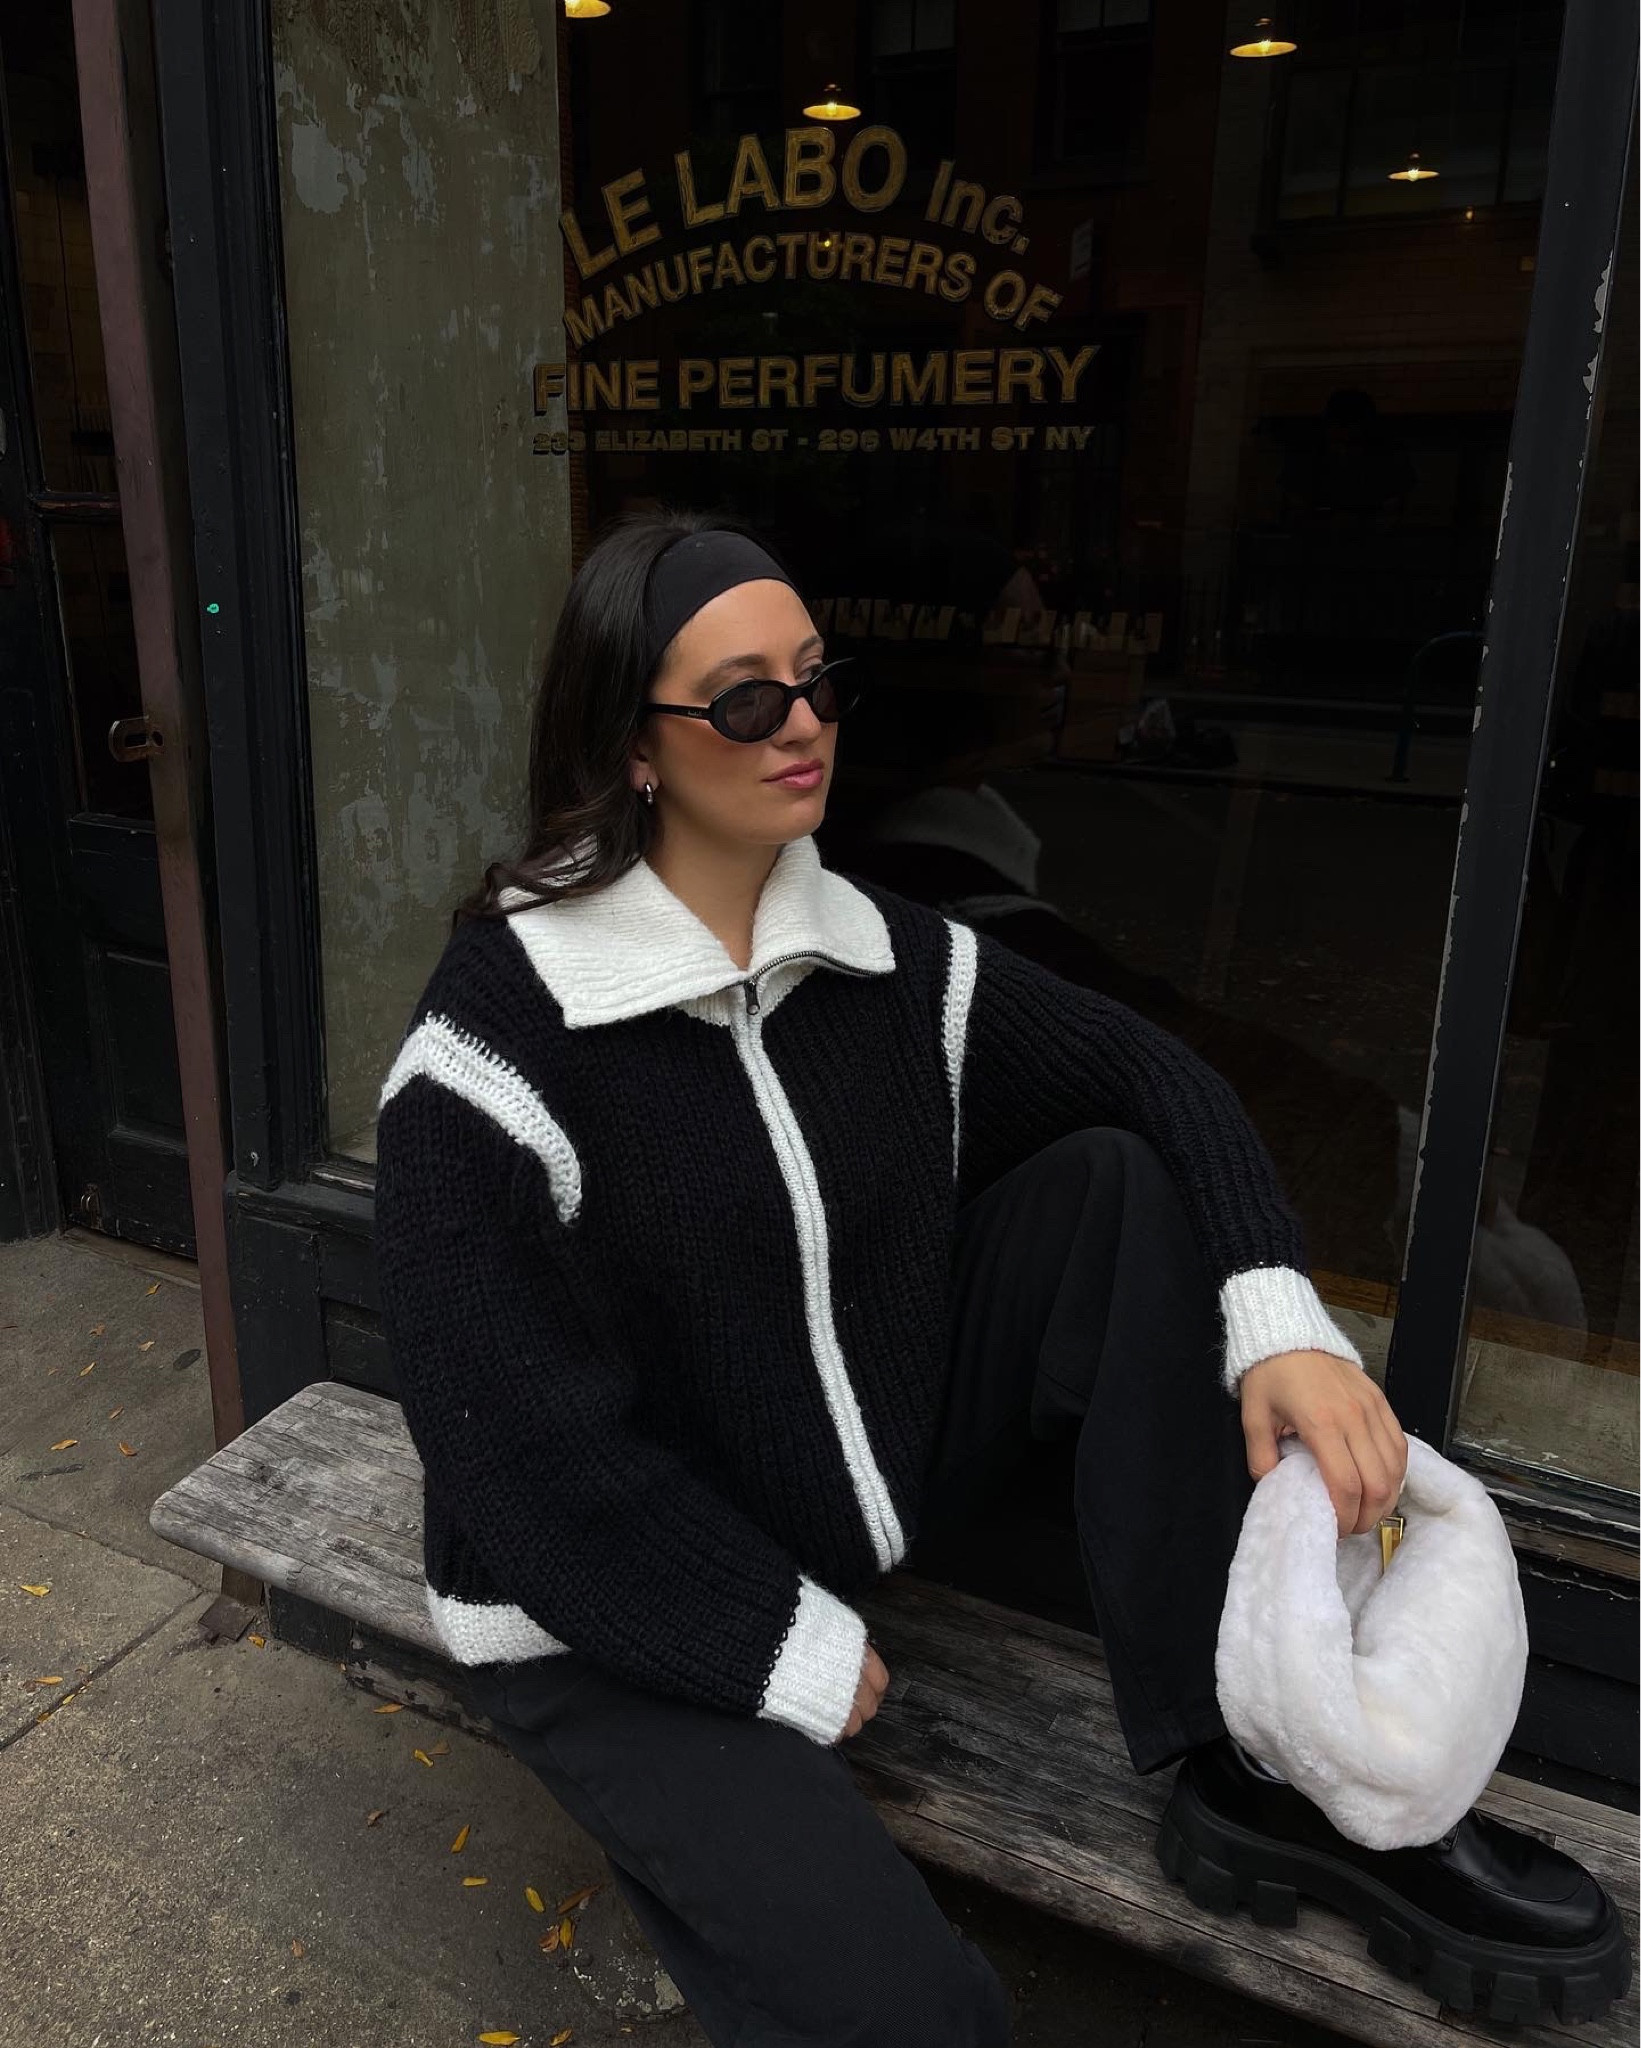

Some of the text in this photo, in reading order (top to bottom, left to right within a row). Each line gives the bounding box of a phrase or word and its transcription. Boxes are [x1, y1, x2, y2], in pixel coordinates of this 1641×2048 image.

[559, 125, 1031, 281] LE LABO Inc.
[563, 230, 1065, 349] MANUFACTURERS OF
[533, 344, 1101, 416] FINE PERFUMERY
[594, 427, 743, 453] ELIZABETH
[750, 427, 789, 452] ST
[818, 427, 882, 452] 296
[888, 426, 982, 452] W4TH
[990, 425, 1036, 452] ST
[1044, 425, 1097, 452] NY
